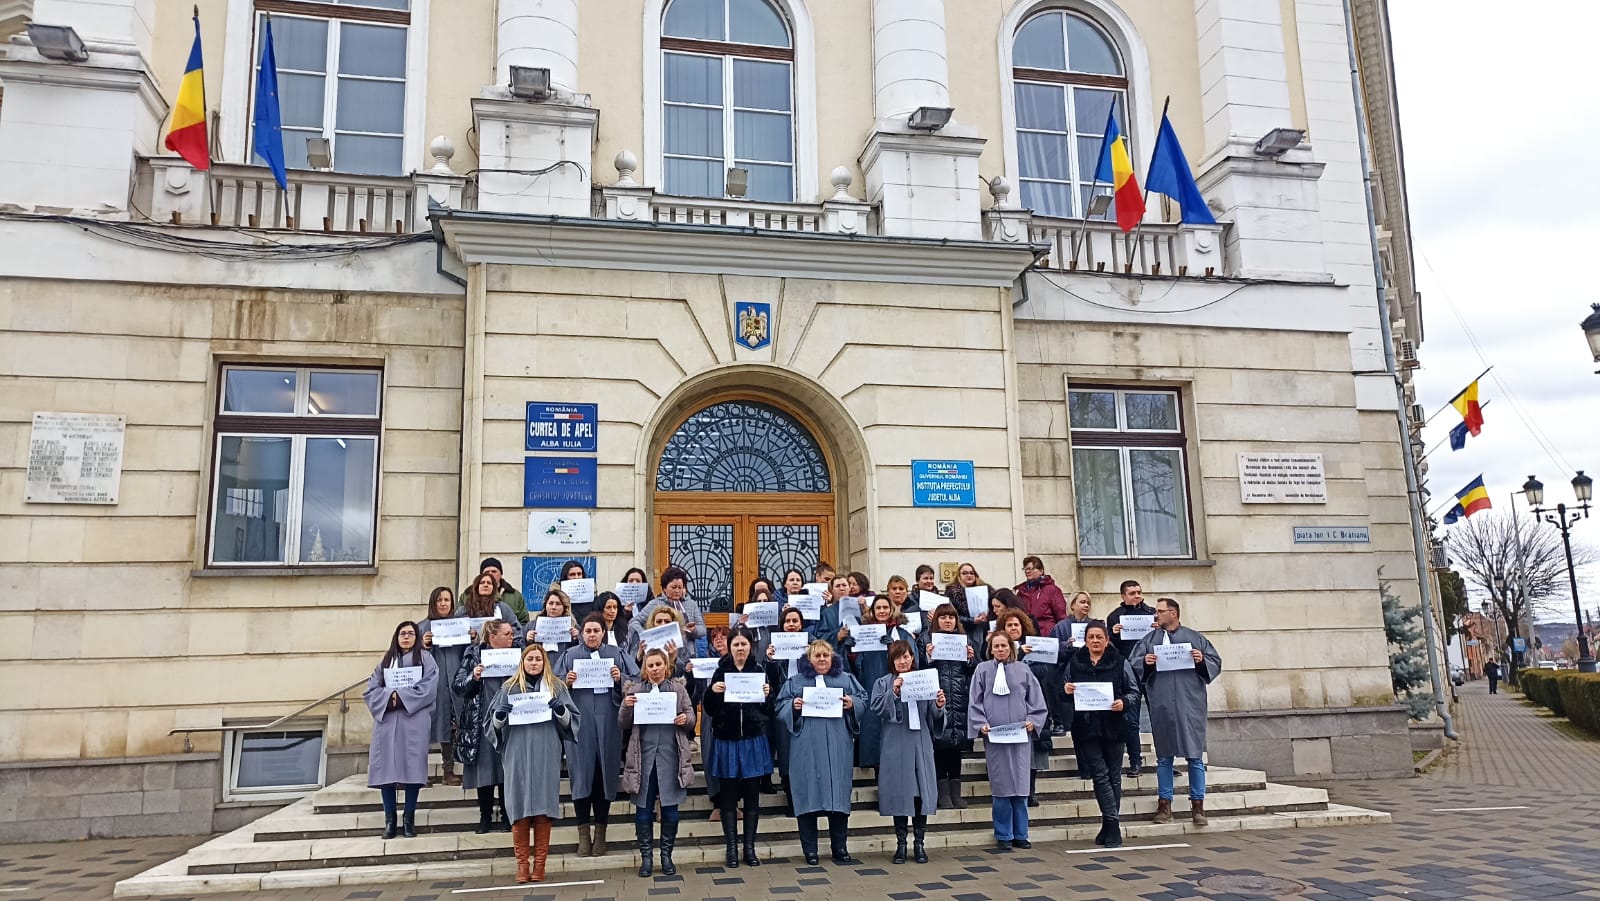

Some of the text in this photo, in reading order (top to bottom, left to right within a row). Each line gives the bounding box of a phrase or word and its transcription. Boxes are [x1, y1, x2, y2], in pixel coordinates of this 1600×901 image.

[530, 421, 593, 438] CURTEA DE APEL
[949, 494, 961, 502] ALBA
